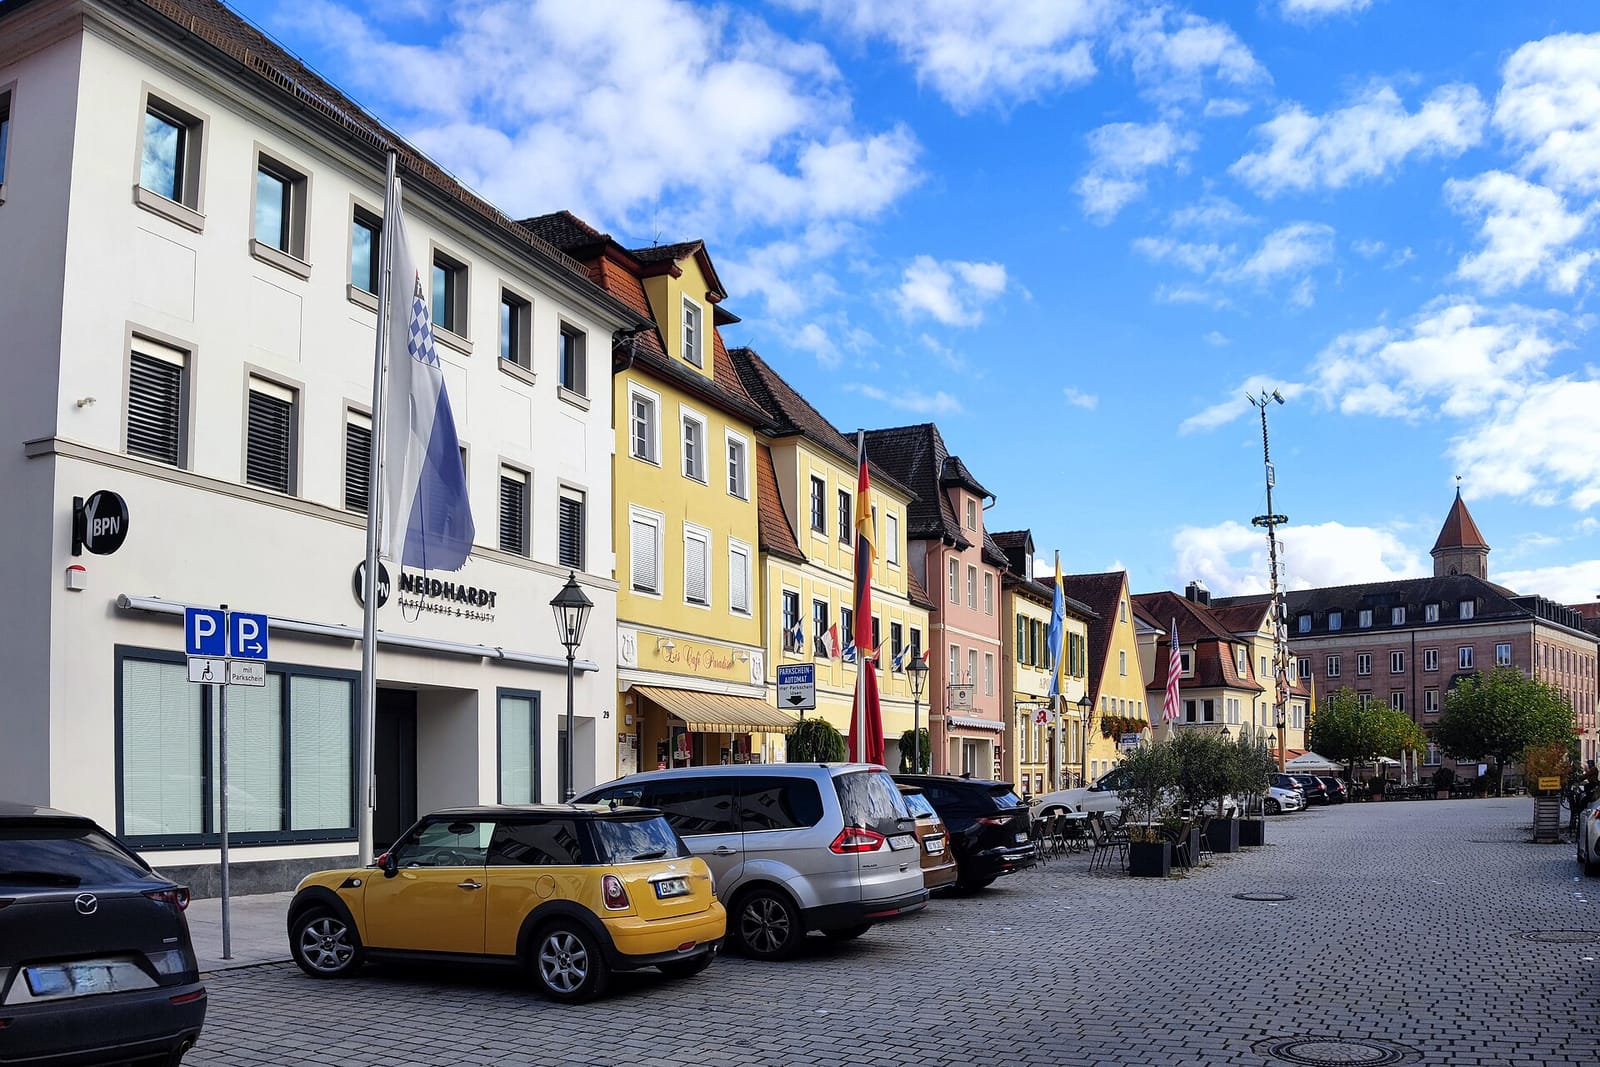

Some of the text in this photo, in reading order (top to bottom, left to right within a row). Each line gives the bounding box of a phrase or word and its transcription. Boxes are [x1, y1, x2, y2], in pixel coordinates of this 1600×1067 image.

[400, 572, 497, 608] NEIDHARDT
[464, 609, 495, 622] BEAUTY
[195, 614, 216, 649] P
[239, 618, 259, 652] P
[232, 673, 263, 681] Parkschein
[784, 675, 808, 684] AUTOMAT
